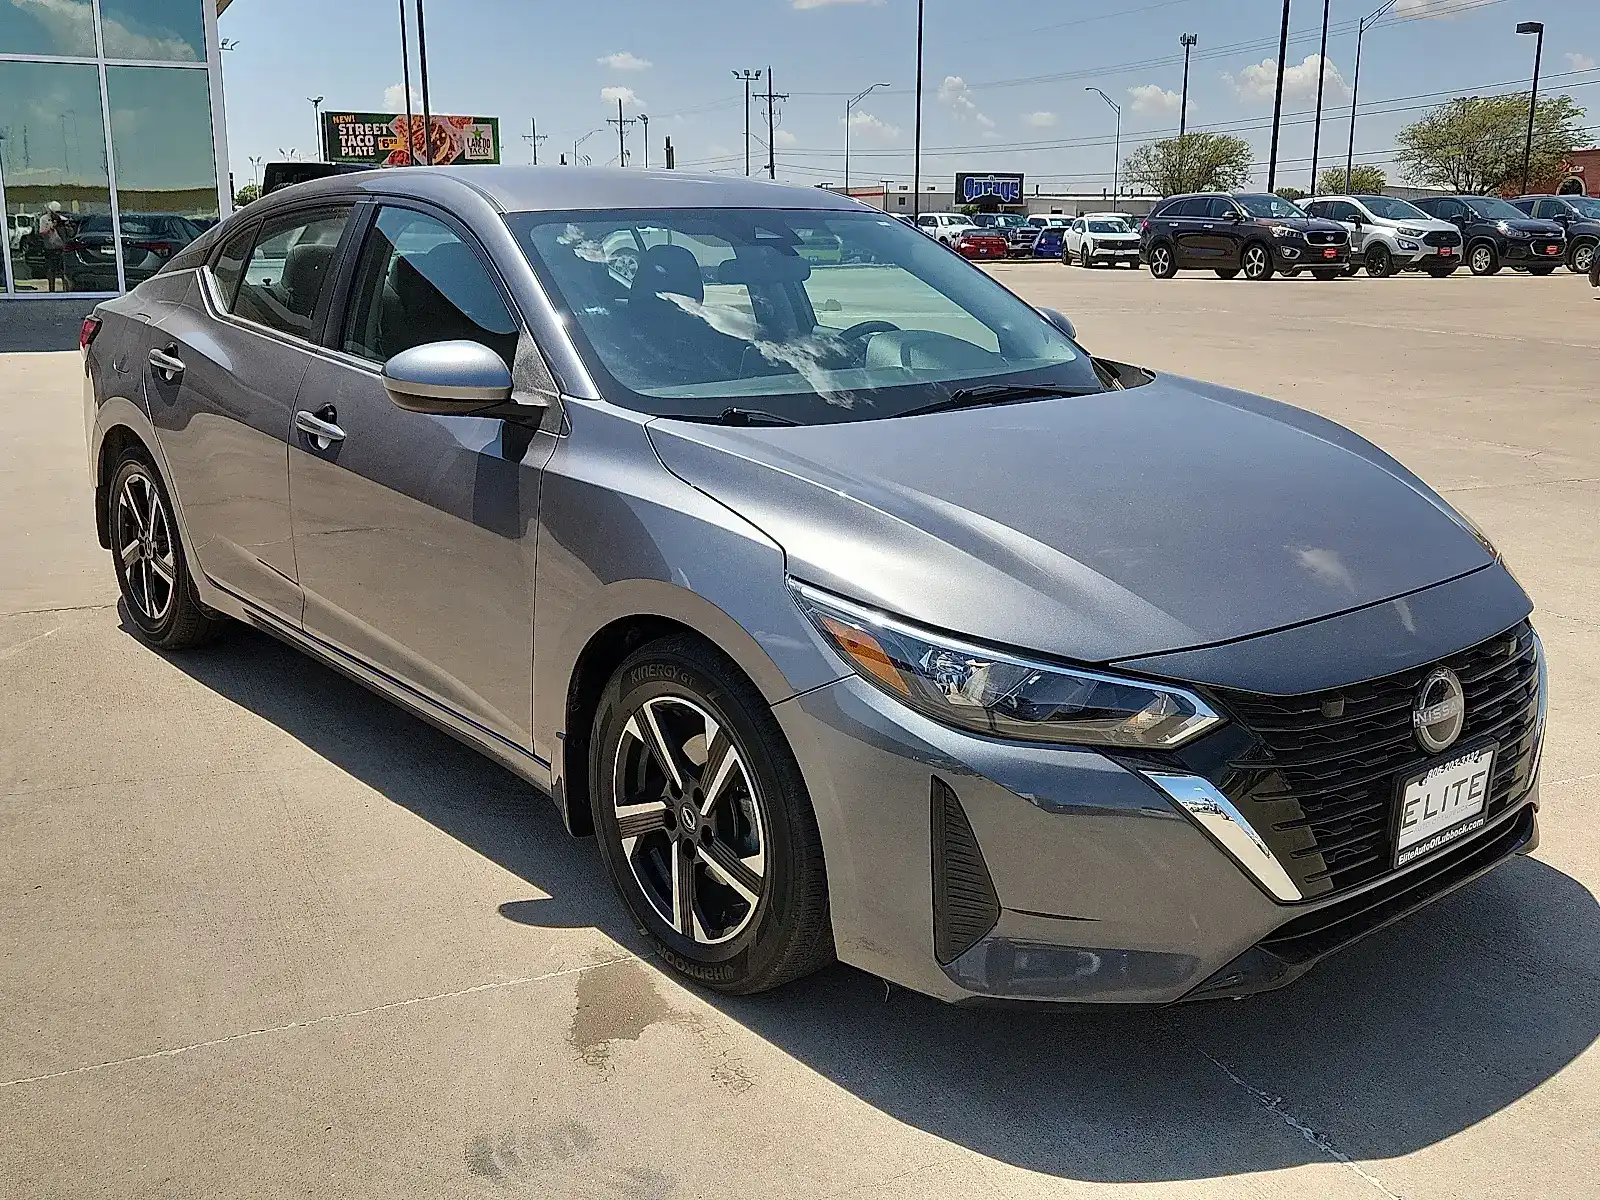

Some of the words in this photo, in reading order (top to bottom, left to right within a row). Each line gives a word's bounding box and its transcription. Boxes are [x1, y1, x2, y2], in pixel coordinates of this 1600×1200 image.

[333, 115, 355, 124] NEW!
[338, 123, 389, 135] STREET
[339, 135, 374, 146] TACO
[341, 147, 375, 156] PLATE
[964, 177, 1020, 202] Garage
[681, 673, 695, 686] GT
[1402, 770, 1486, 829] ELITE
